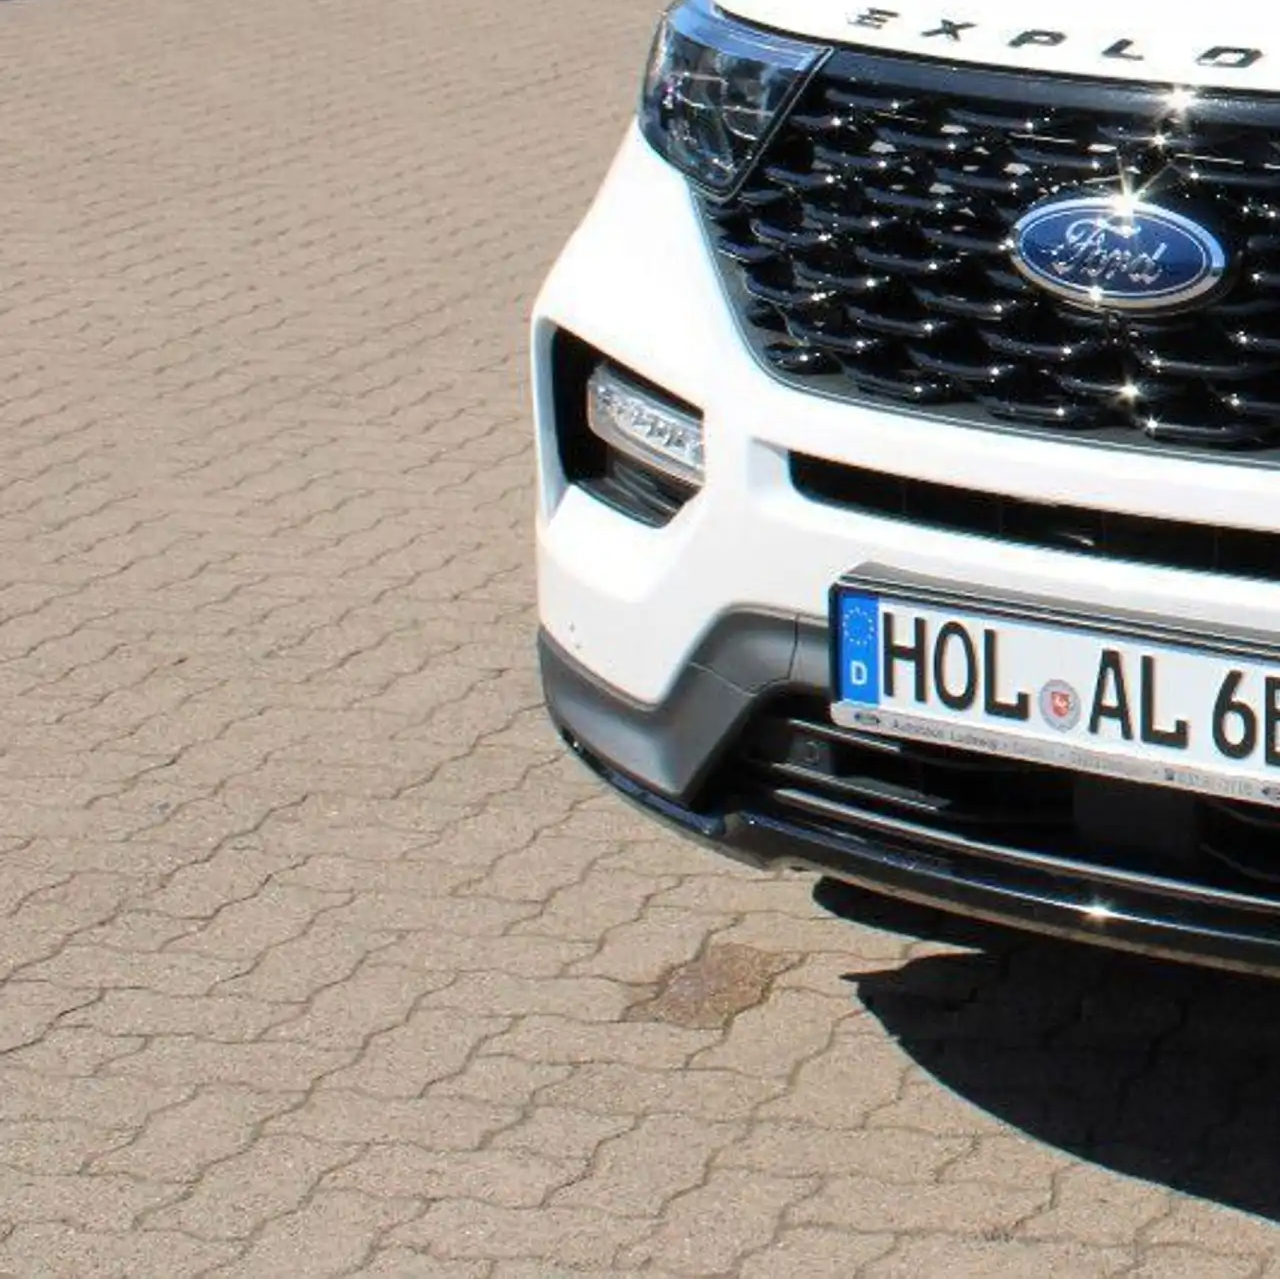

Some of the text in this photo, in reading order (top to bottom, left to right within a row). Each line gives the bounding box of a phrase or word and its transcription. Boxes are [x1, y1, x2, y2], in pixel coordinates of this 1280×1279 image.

[1041, 217, 1168, 286] Ford
[851, 659, 868, 686] D
[882, 611, 1030, 721] HOL
[1088, 647, 1189, 750] AL
